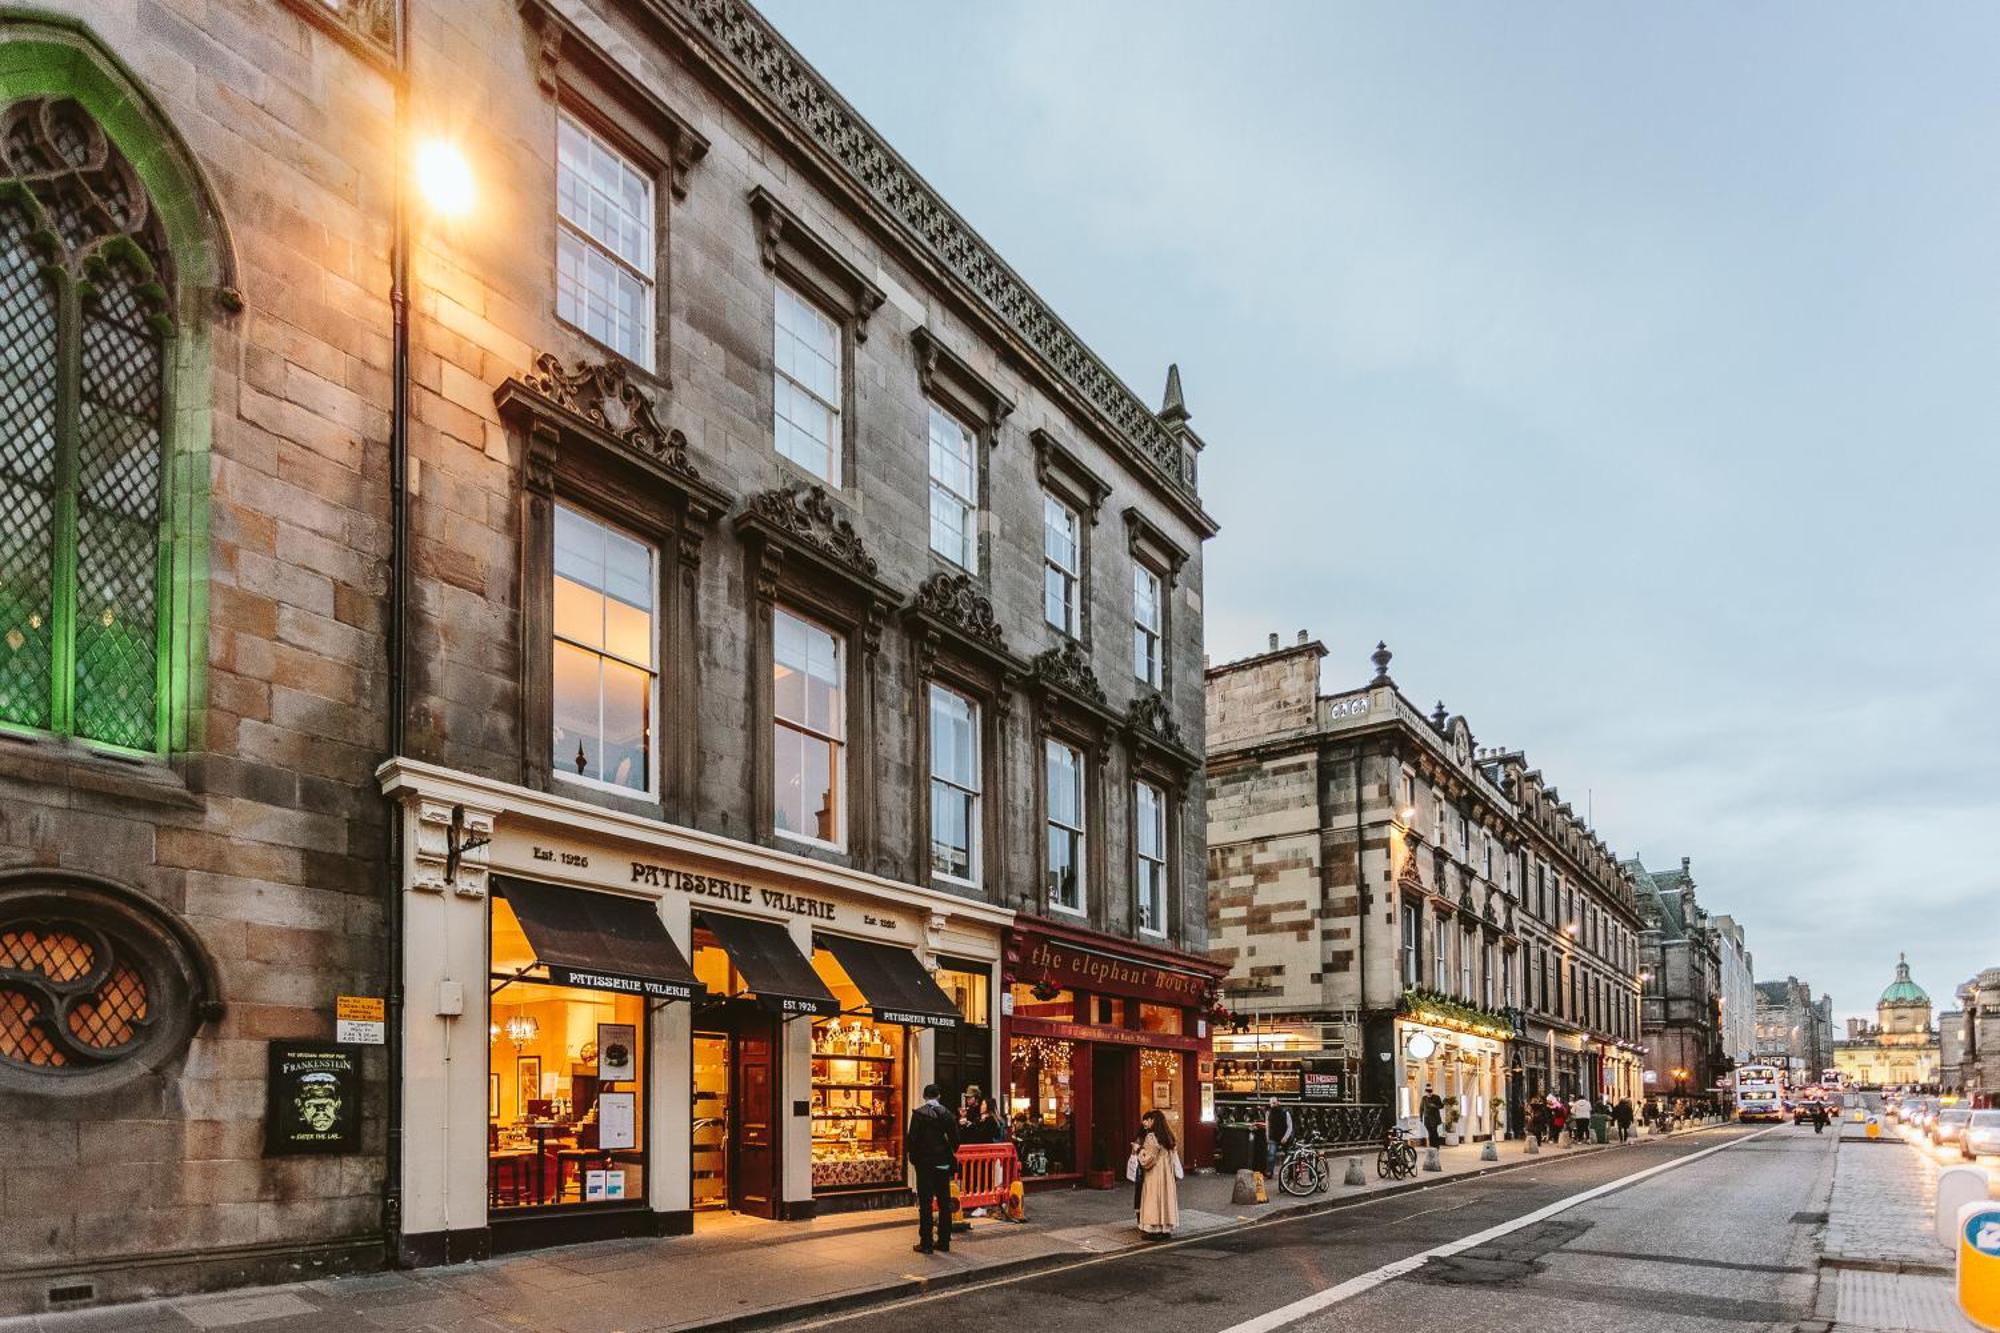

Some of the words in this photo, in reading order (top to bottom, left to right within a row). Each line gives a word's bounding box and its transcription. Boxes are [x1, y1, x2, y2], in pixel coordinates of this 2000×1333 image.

[533, 847, 557, 862] Est.
[561, 853, 589, 868] 1926
[631, 862, 752, 903] PATISSERIE
[761, 888, 836, 921] VALERIE
[1032, 944, 1062, 968] the
[1072, 955, 1147, 984] elephant
[1155, 970, 1198, 994] house
[569, 972, 641, 991] PATISSERIE
[645, 982, 691, 998] VALERIE
[799, 1002, 817, 1013] 1926
[884, 1011, 926, 1025] PATISSERIE
[927, 1016, 956, 1028] VALERIE
[283, 1059, 352, 1074] FRANKENSTEIN
